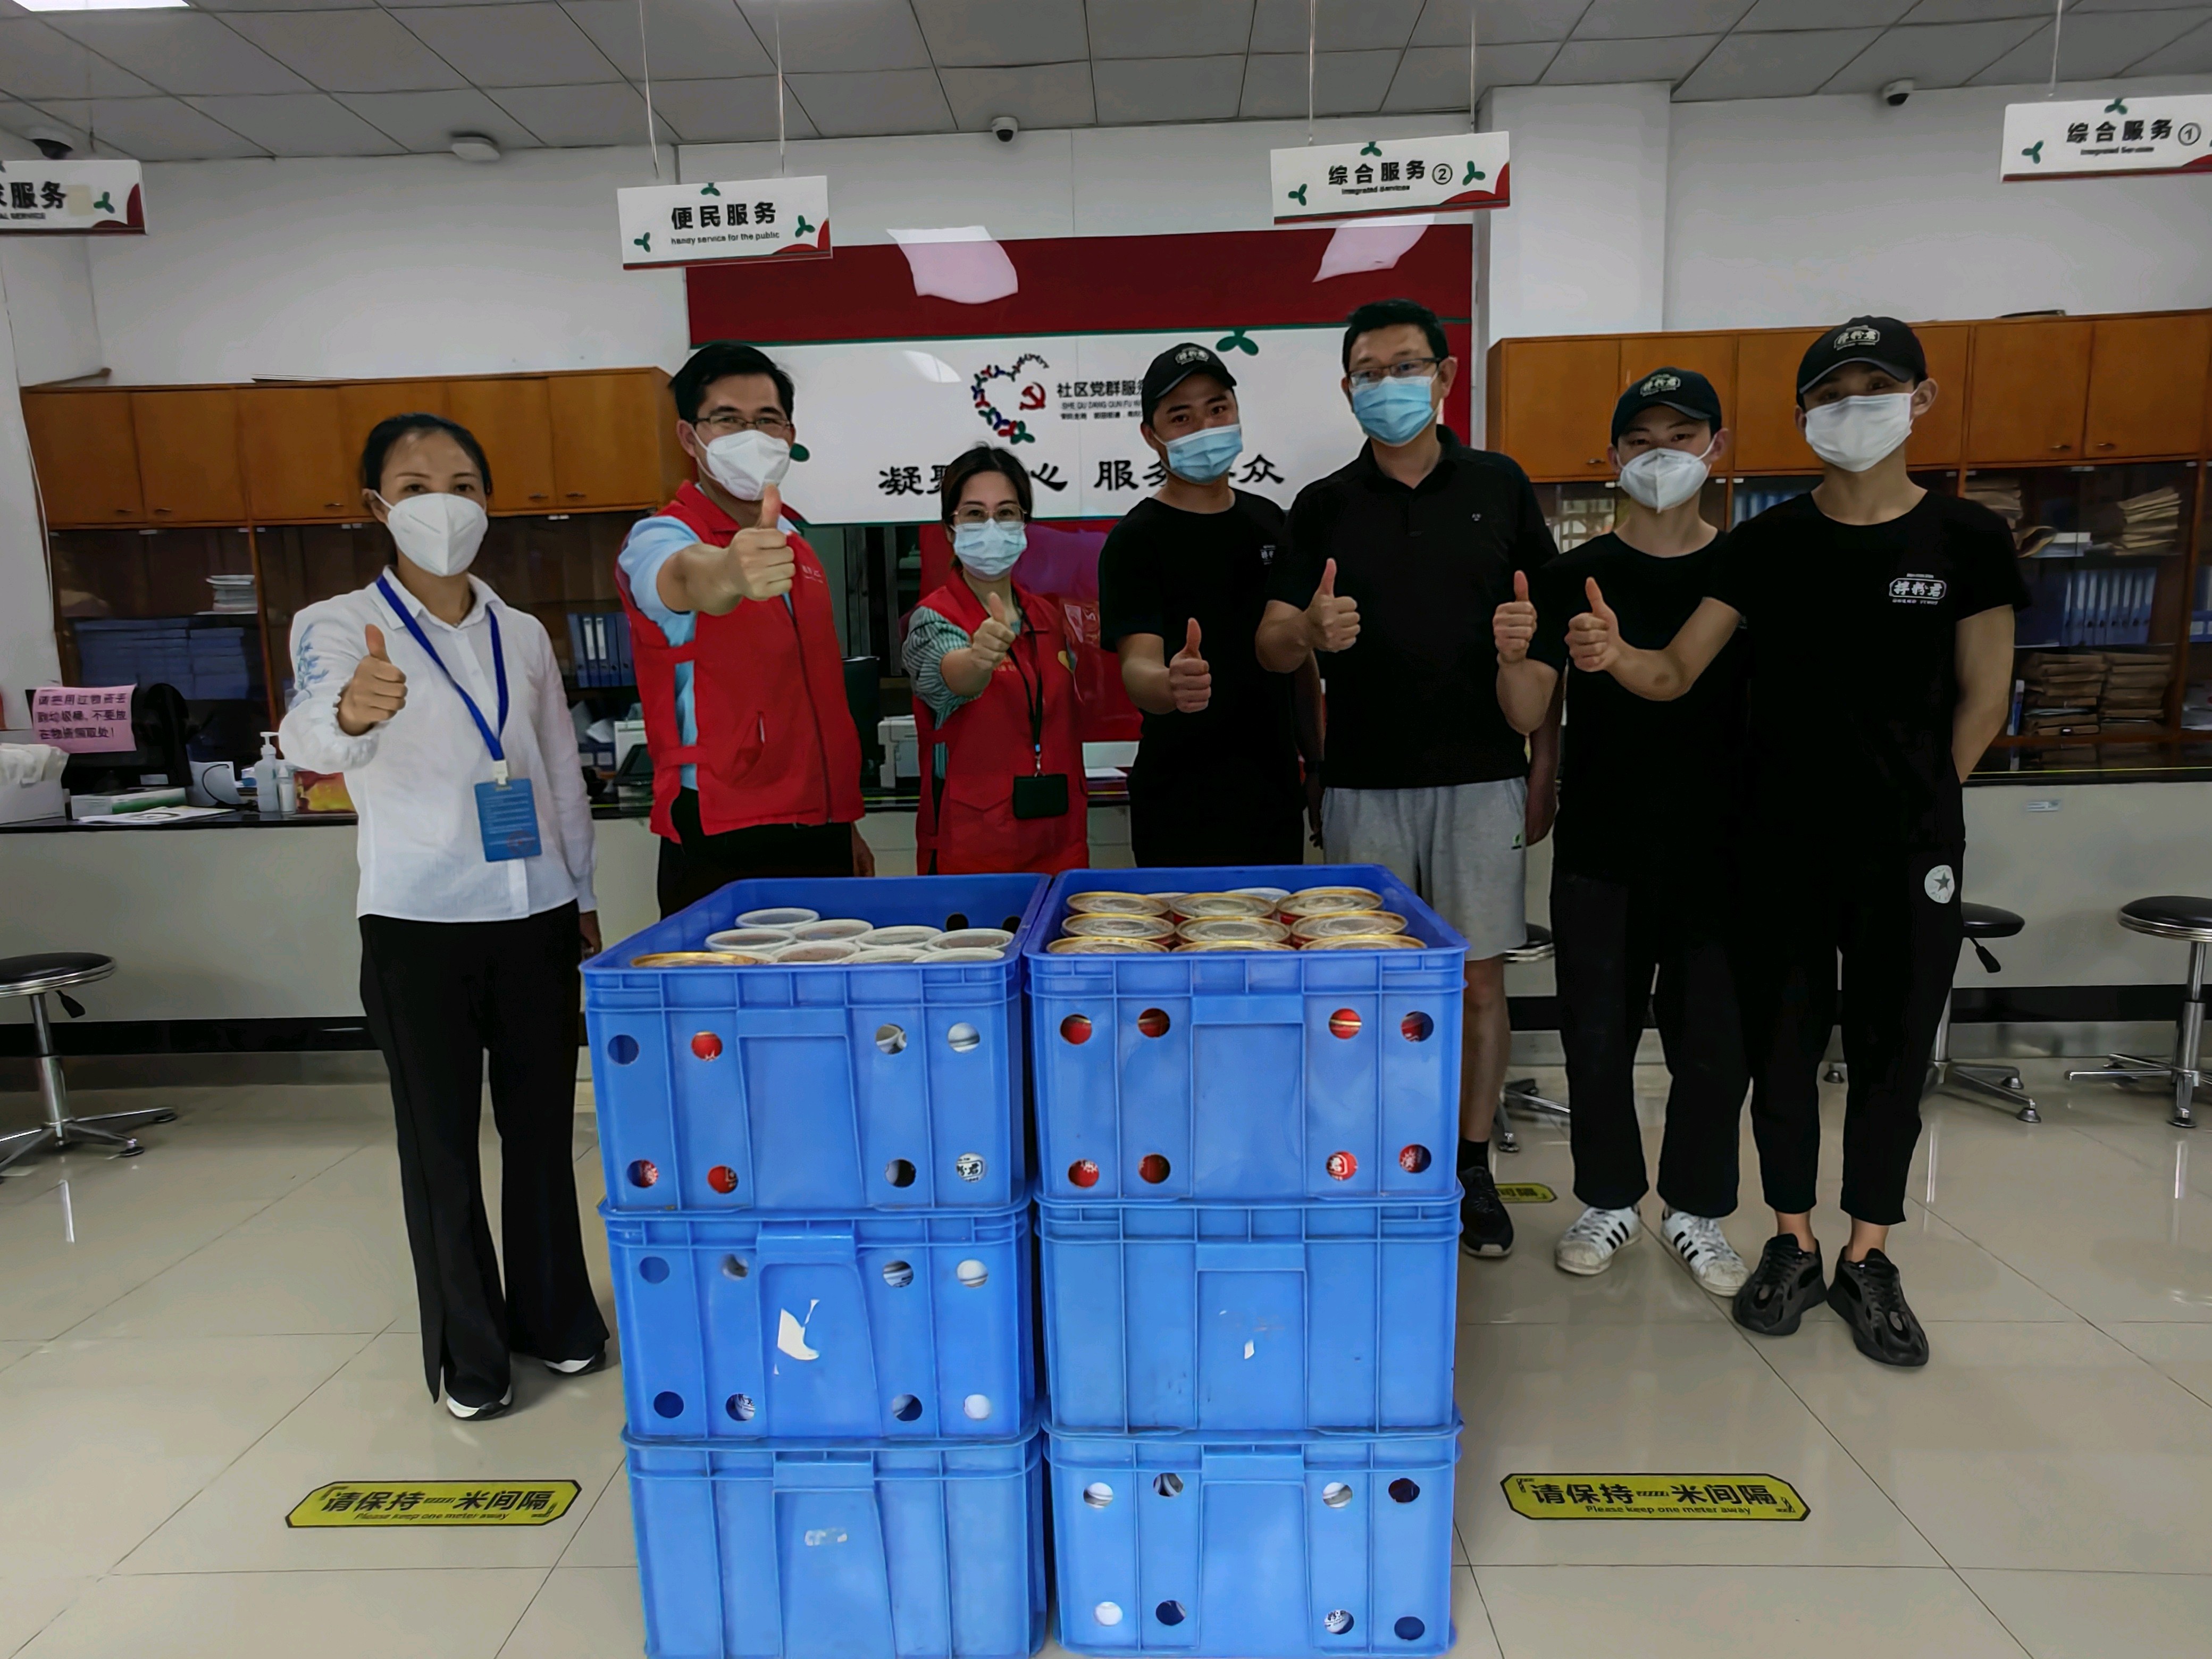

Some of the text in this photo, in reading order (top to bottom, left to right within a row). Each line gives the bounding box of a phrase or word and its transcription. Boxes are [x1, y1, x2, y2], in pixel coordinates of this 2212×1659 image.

[671, 201, 776, 230] 便民服务
[756, 231, 780, 241] public
[1625, 1505, 1655, 1514] keep
[1720, 1506, 1751, 1515] away
